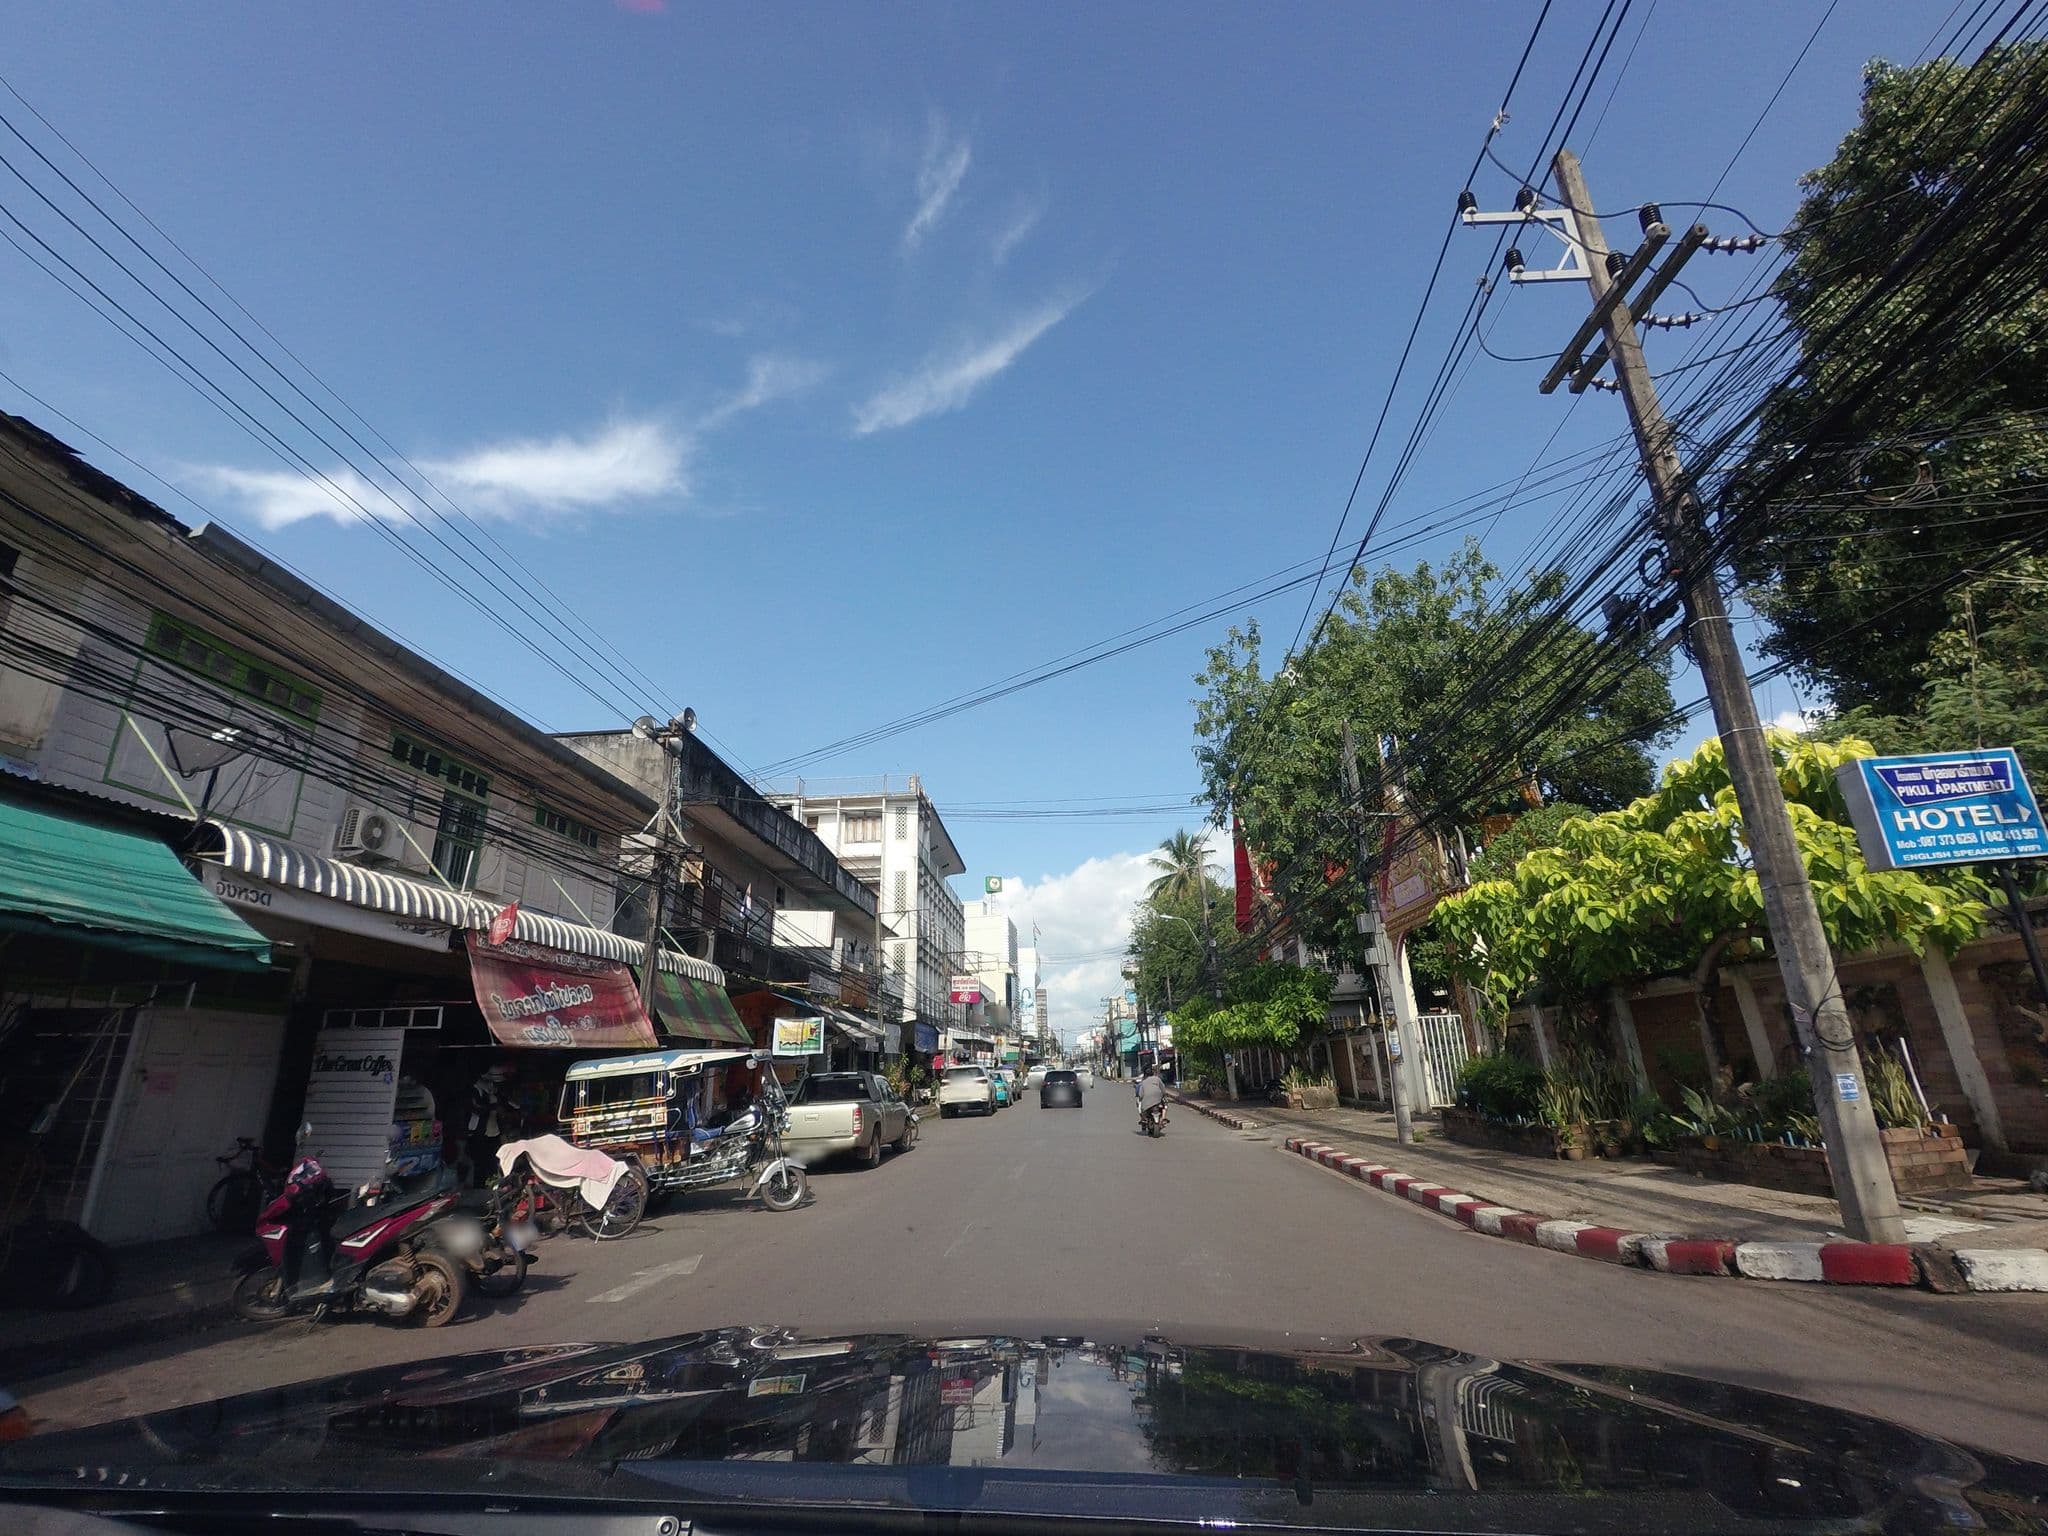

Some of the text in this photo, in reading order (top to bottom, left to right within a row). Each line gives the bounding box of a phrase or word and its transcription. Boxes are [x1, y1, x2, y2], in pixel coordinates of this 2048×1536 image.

[1896, 779, 2006, 797] PIKUL APARTMENT
[1893, 804, 2019, 832] HOTEL
[1902, 851, 1952, 862] ENGLISH
[1953, 845, 2010, 858] SPEAKING
[363, 1055, 394, 1077] Coffee
